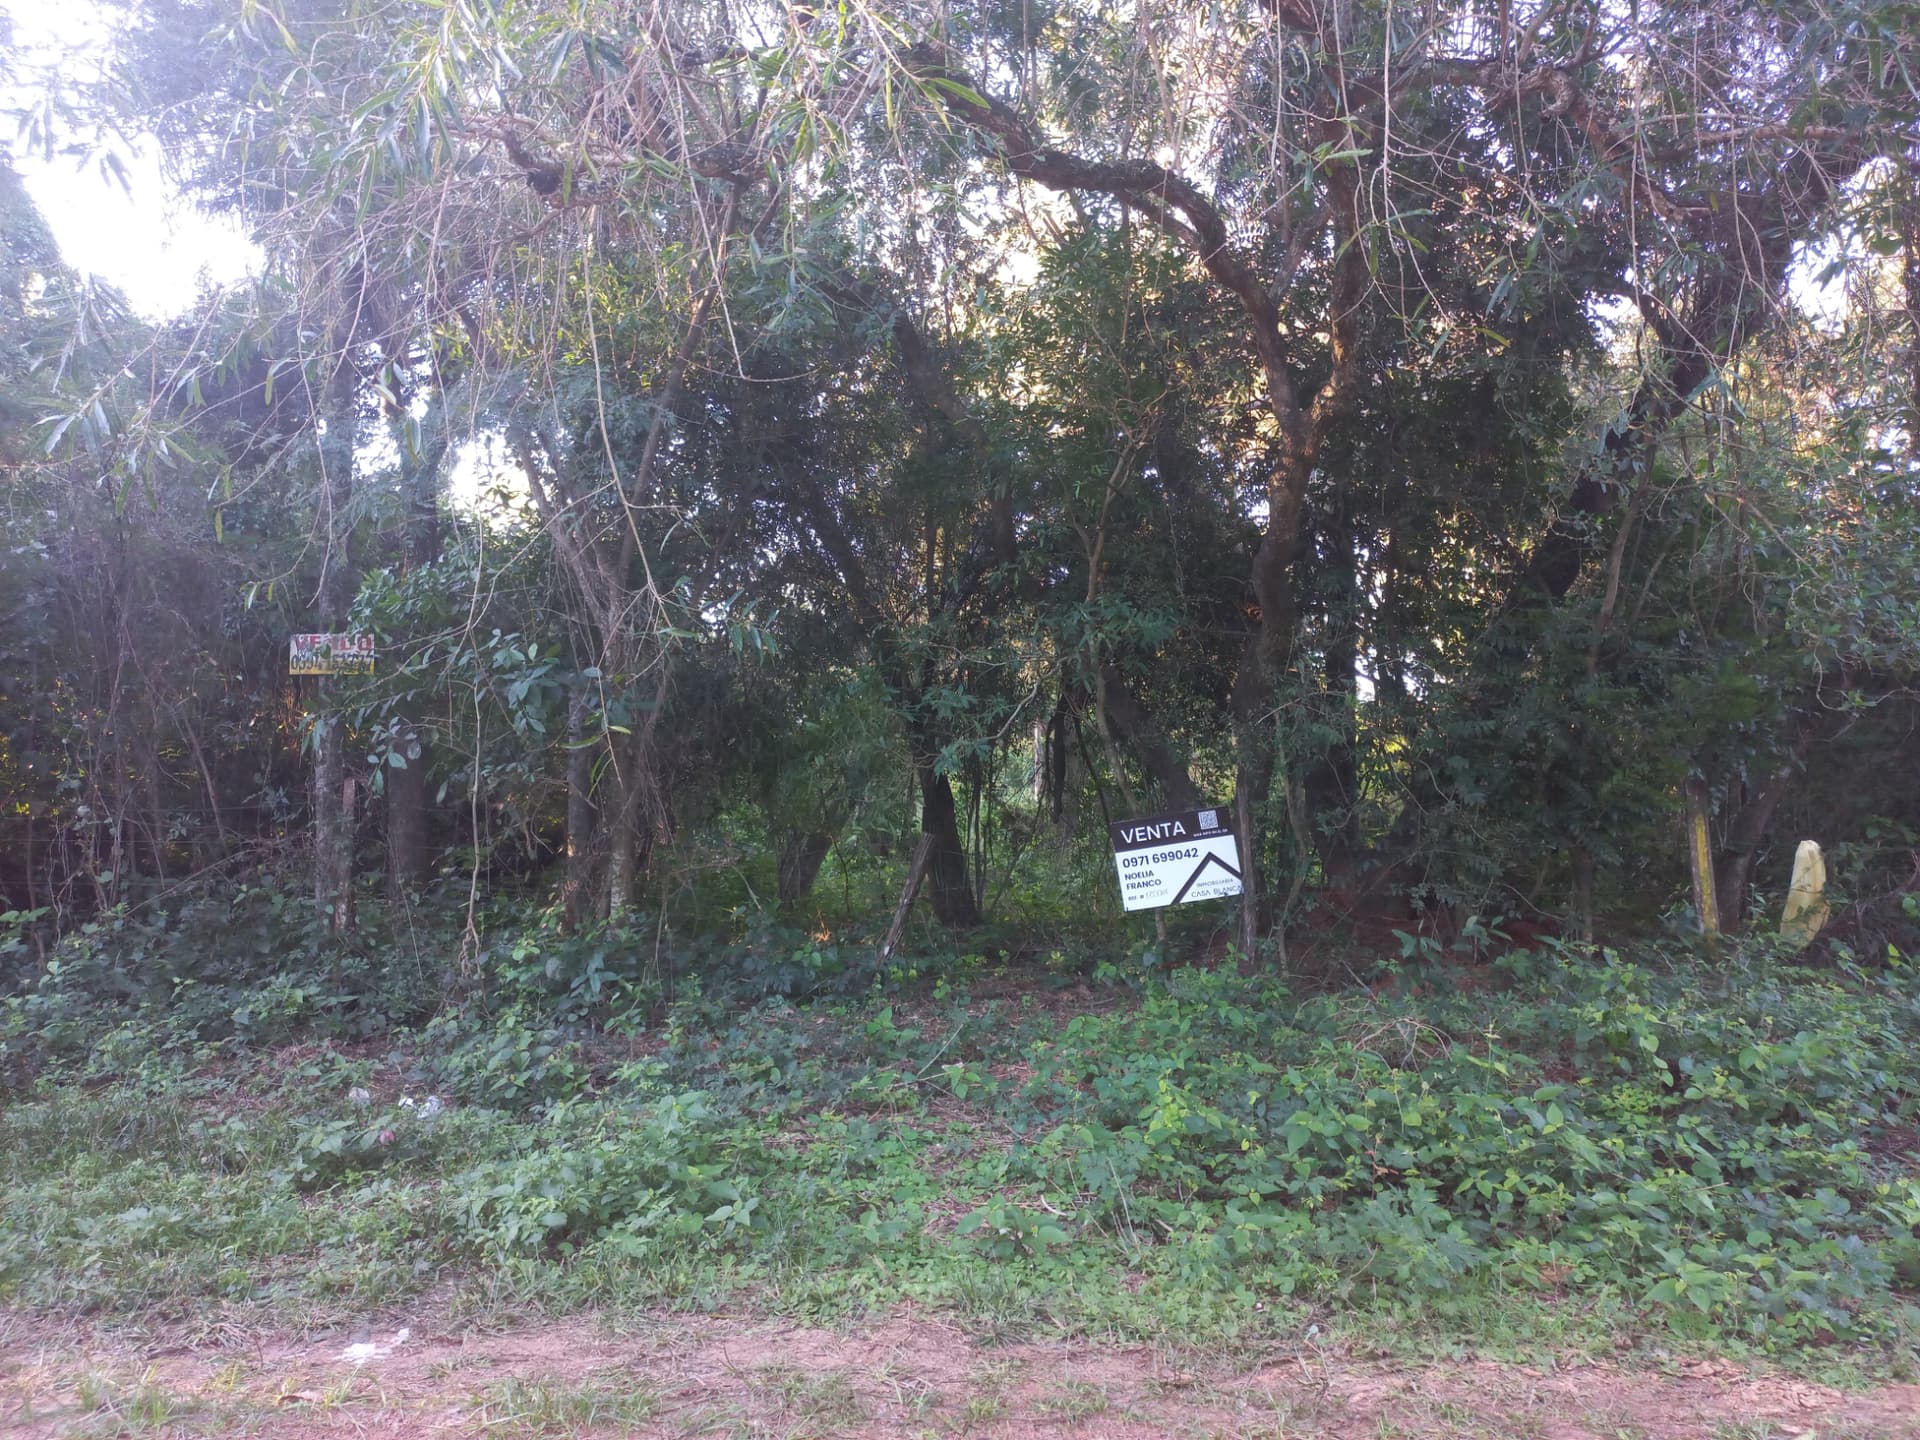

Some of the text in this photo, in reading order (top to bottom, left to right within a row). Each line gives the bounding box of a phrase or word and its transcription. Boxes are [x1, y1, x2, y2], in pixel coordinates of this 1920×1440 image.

[295, 635, 373, 651] VEDO
[1121, 820, 1186, 844] VENTA
[1122, 847, 1199, 868] 0971 699042
[1124, 869, 1154, 881] NOELIA
[1126, 878, 1162, 890] FRANCO
[1191, 888, 1211, 897] CASA
